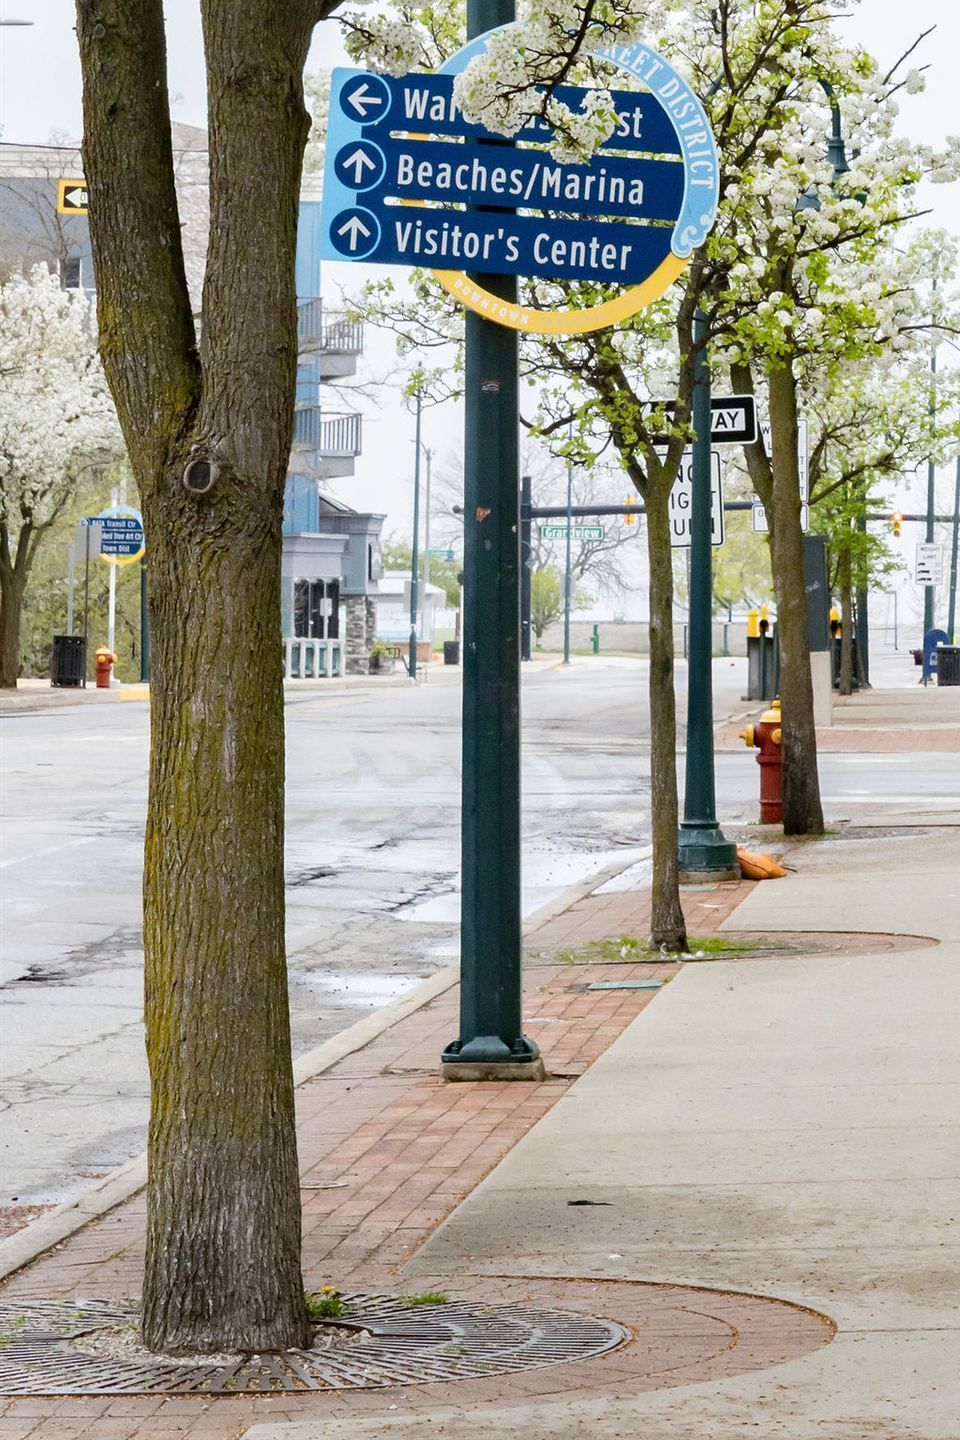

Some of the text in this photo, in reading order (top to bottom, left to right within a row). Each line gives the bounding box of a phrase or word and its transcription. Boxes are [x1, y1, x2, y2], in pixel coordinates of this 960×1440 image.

[658, 76, 714, 191] DISTRICT
[397, 154, 644, 206] Beaches/Marina
[395, 220, 633, 271] Visitor's Center
[454, 277, 529, 325] DOWNTOWN
[711, 410, 739, 430] AY
